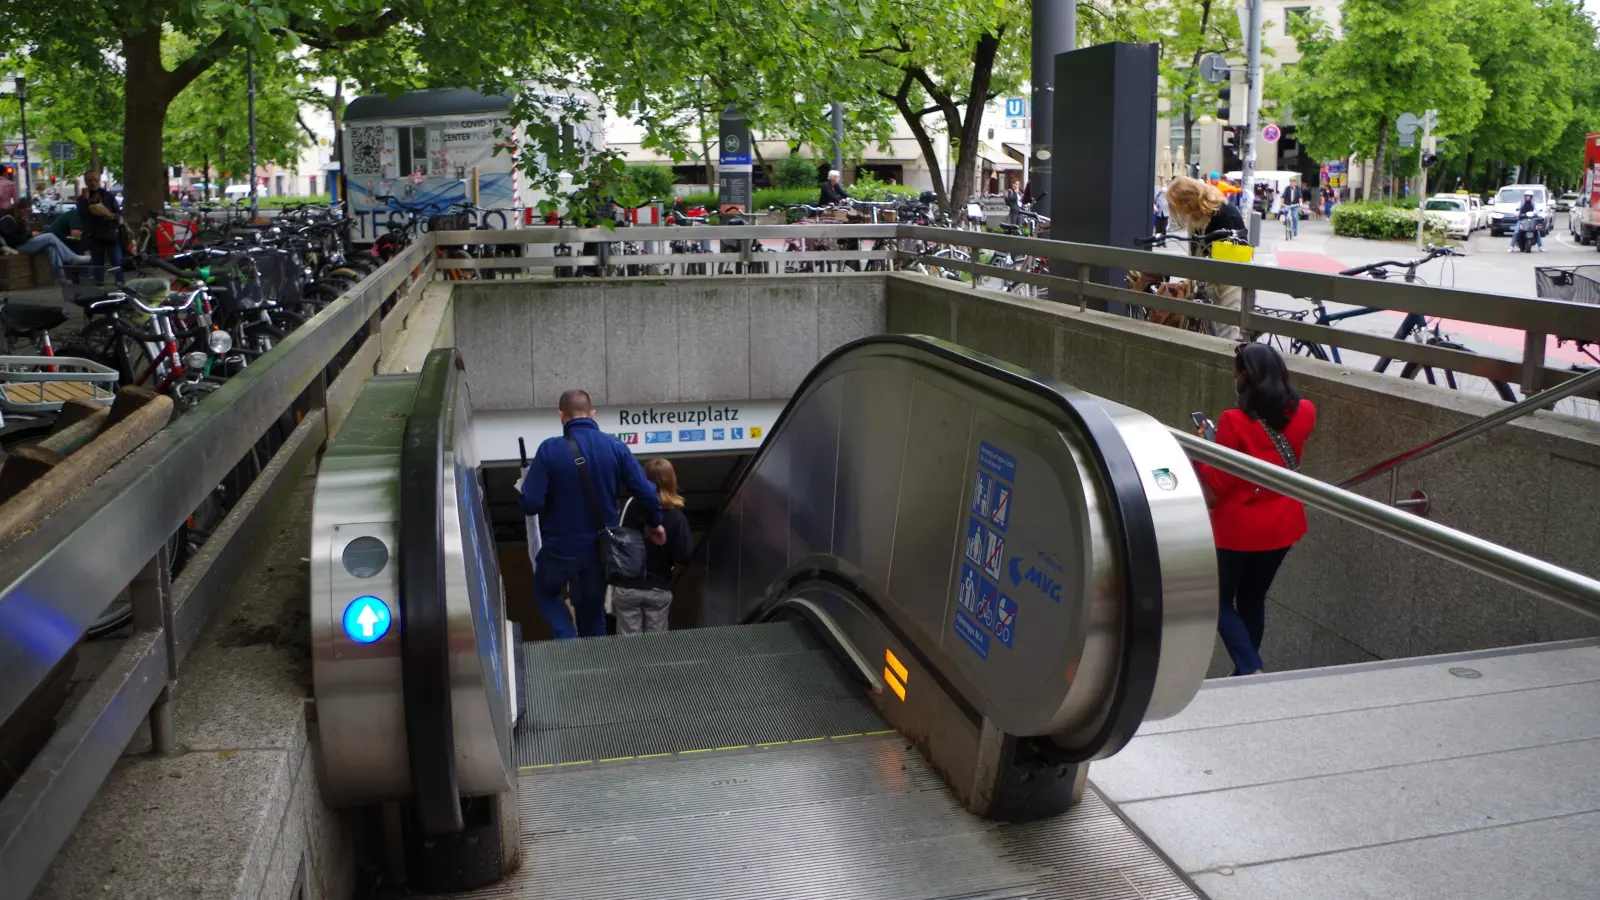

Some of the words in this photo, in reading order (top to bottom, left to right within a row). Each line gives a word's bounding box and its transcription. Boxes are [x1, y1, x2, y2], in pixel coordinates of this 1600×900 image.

[1009, 101, 1020, 114] U
[461, 119, 498, 129] COVID-19
[443, 132, 471, 142] CENTER
[619, 406, 739, 426] Rotkreuzplatz
[620, 432, 636, 444] U7
[1024, 567, 1062, 603] MVG
